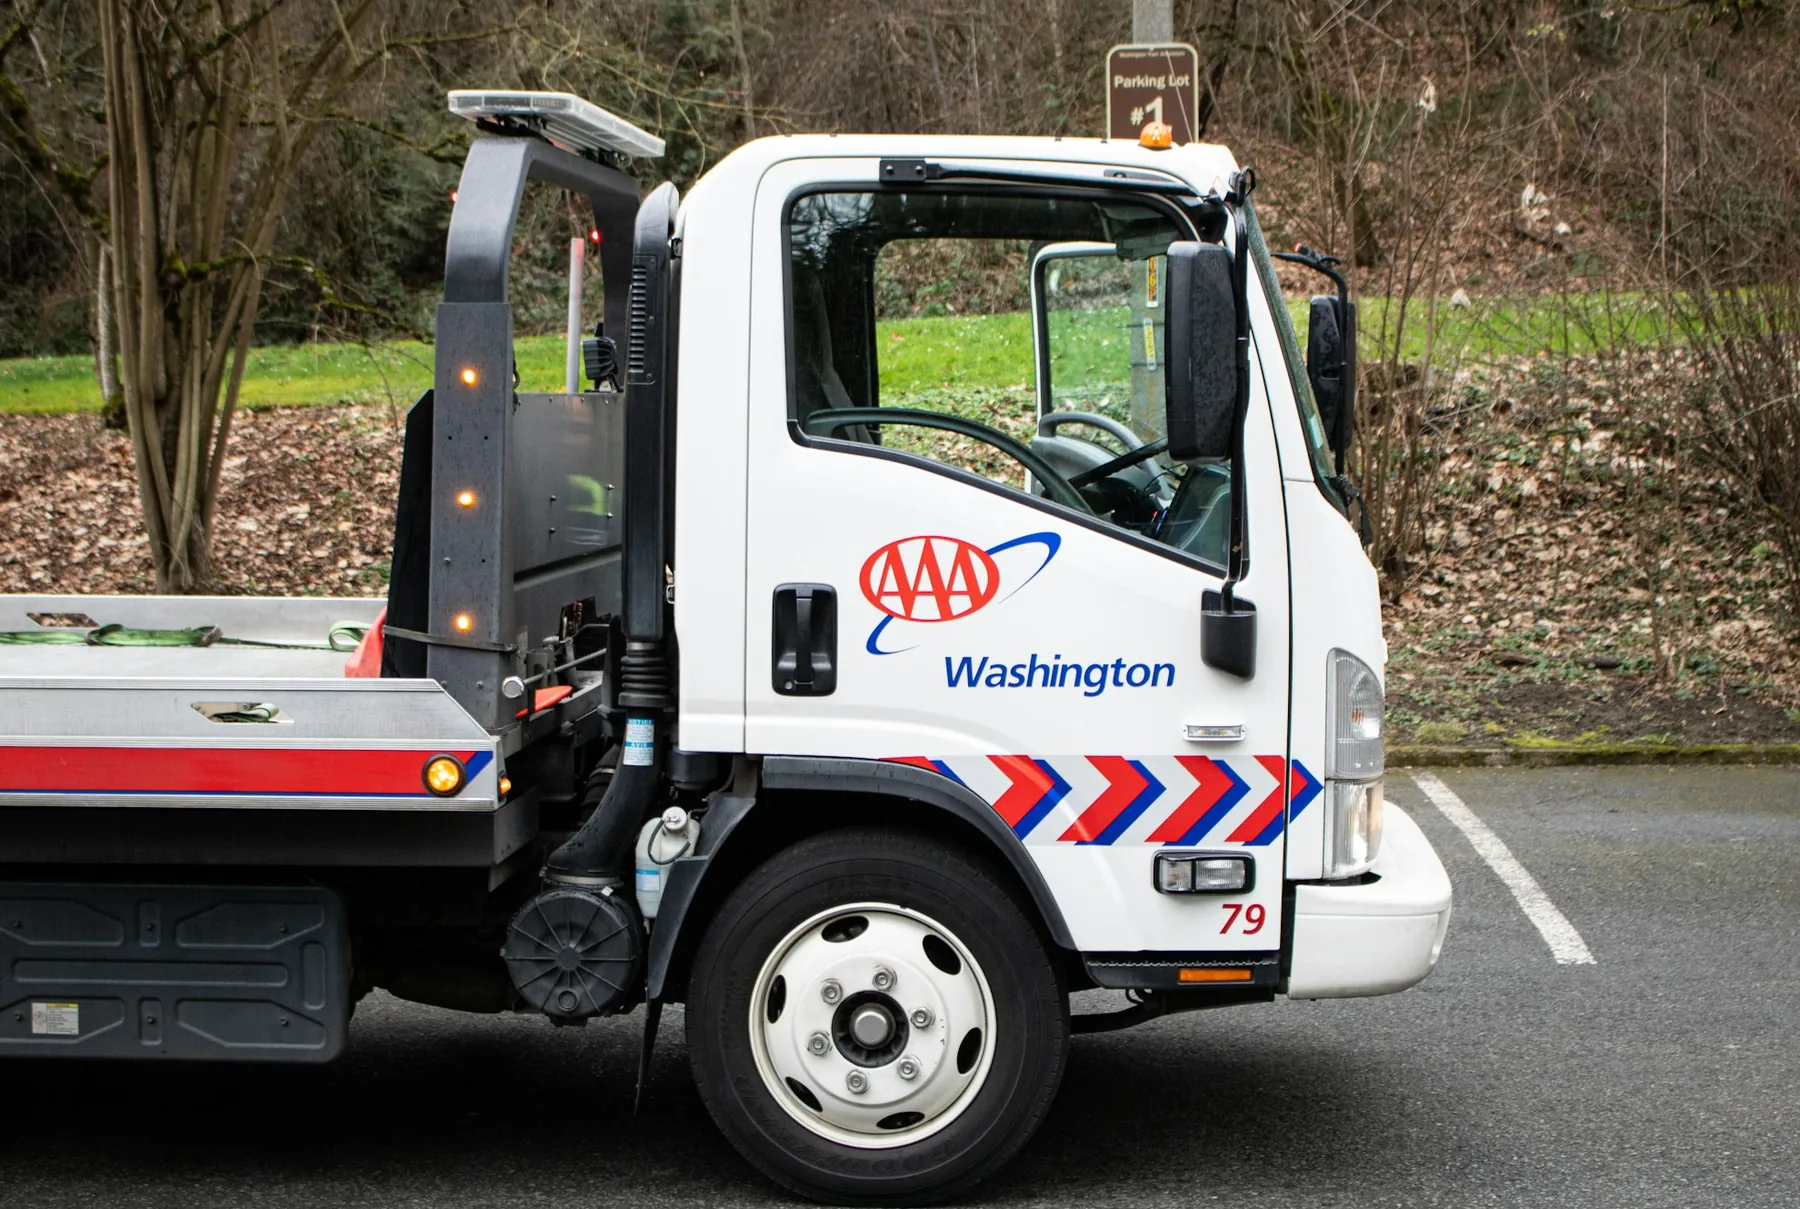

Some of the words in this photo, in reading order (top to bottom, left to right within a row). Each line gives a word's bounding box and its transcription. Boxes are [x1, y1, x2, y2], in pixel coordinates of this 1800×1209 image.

[1114, 74, 1166, 90] Parking
[1168, 74, 1190, 87] Lot
[875, 537, 986, 620] AAA
[944, 654, 1175, 697] Washington
[1219, 903, 1266, 935] 79
